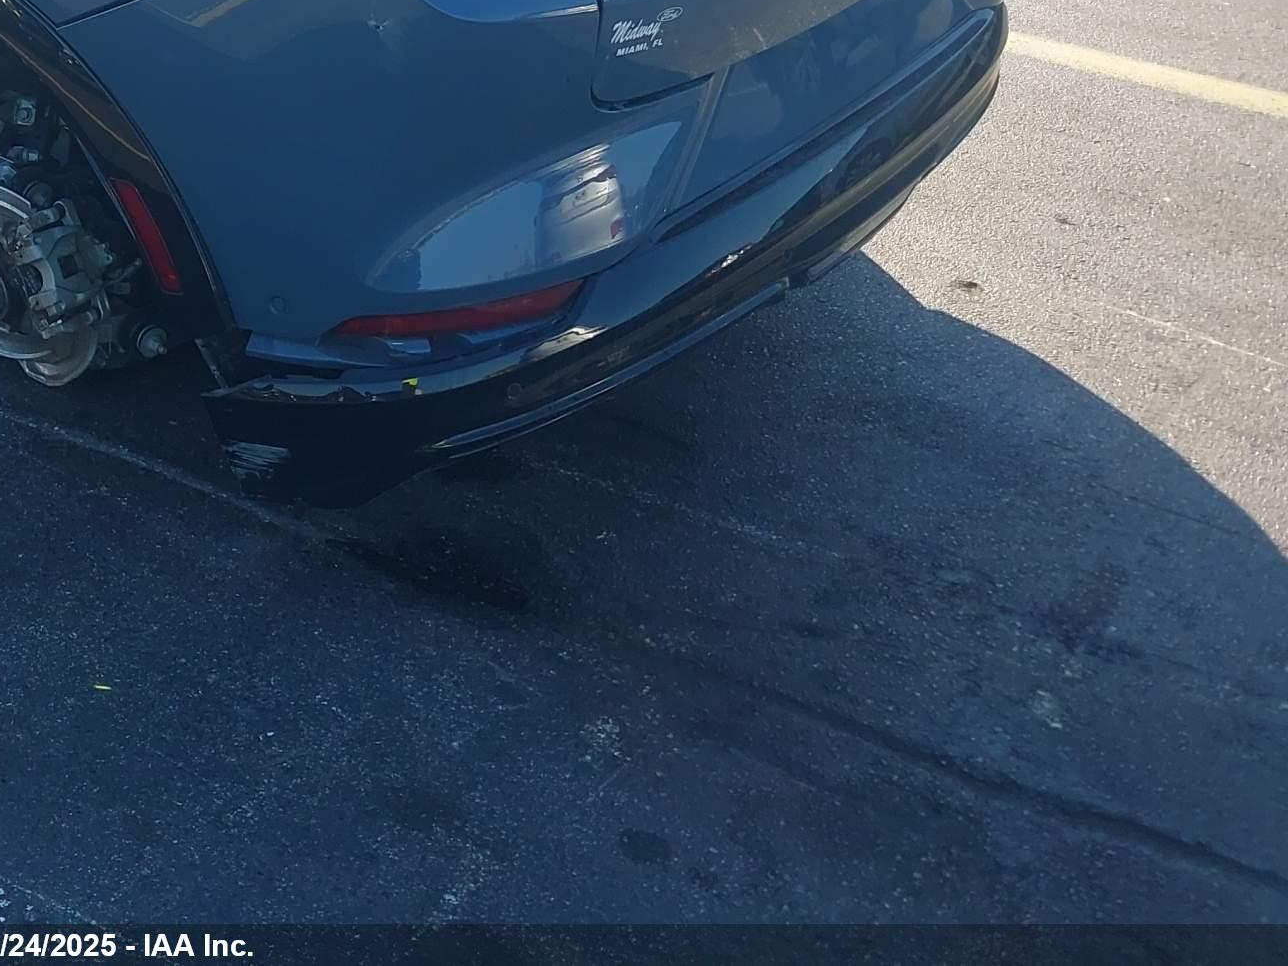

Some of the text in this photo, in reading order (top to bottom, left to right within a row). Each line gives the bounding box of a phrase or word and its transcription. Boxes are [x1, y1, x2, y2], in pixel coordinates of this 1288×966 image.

[611, 19, 662, 44] Midway
[616, 38, 664, 56] MIAMI, FL
